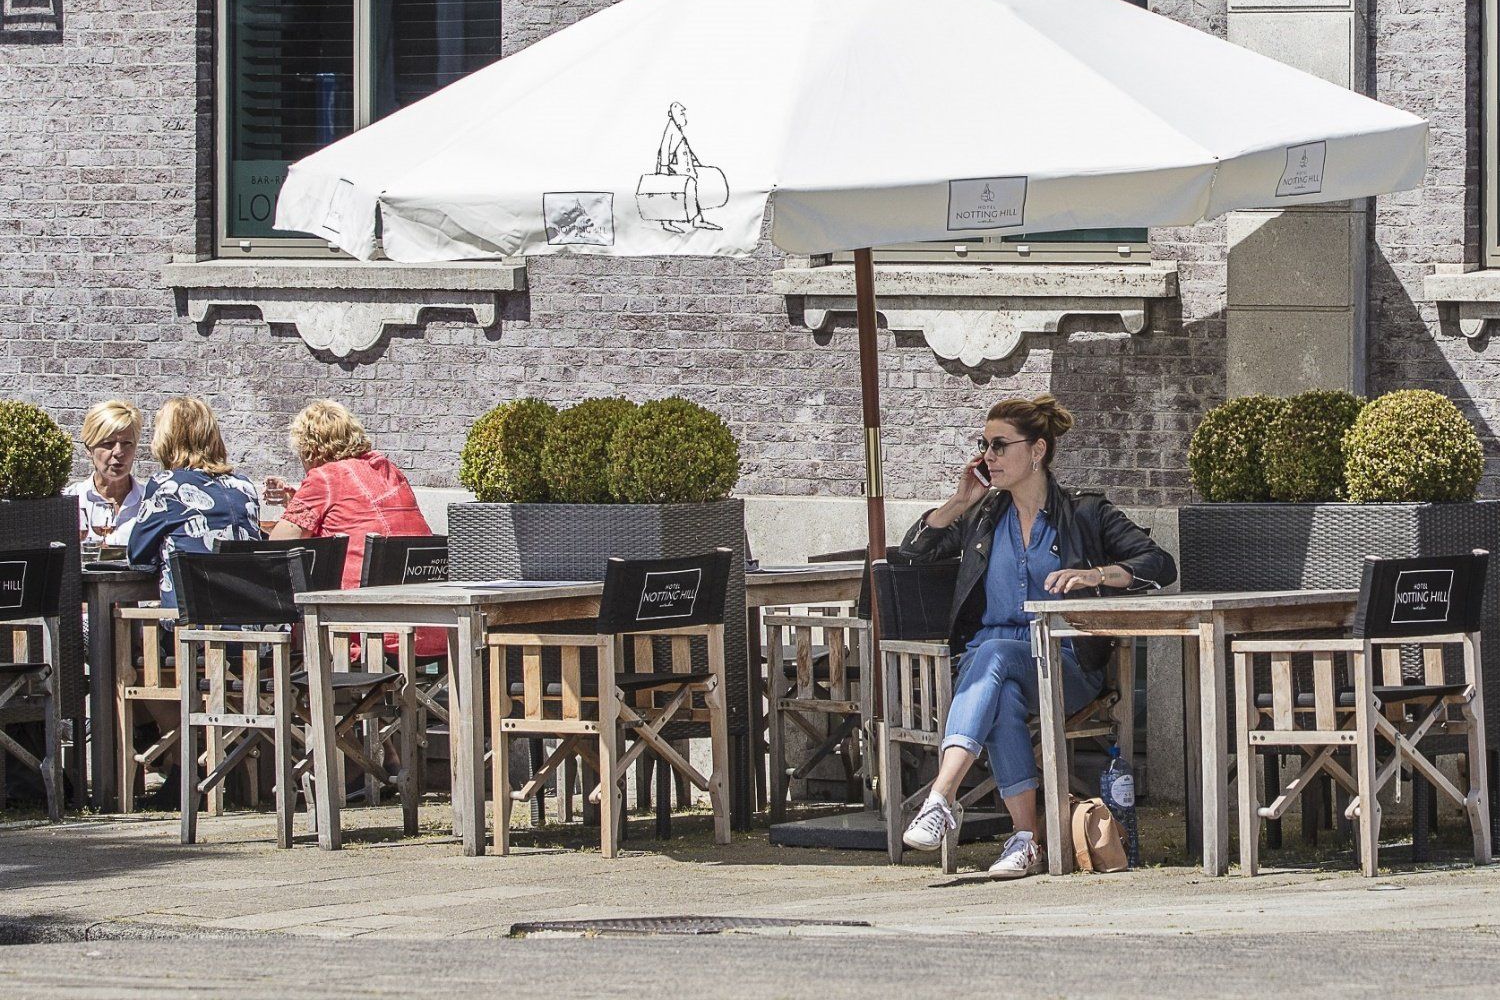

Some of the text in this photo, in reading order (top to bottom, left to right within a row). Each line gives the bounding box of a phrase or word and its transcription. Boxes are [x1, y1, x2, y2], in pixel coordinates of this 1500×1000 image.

[956, 208, 1017, 219] NOTTING HILL
[3, 580, 21, 591] HILL
[643, 589, 696, 603] NOTTING HILL
[1397, 590, 1448, 604] NOTTING HILL
